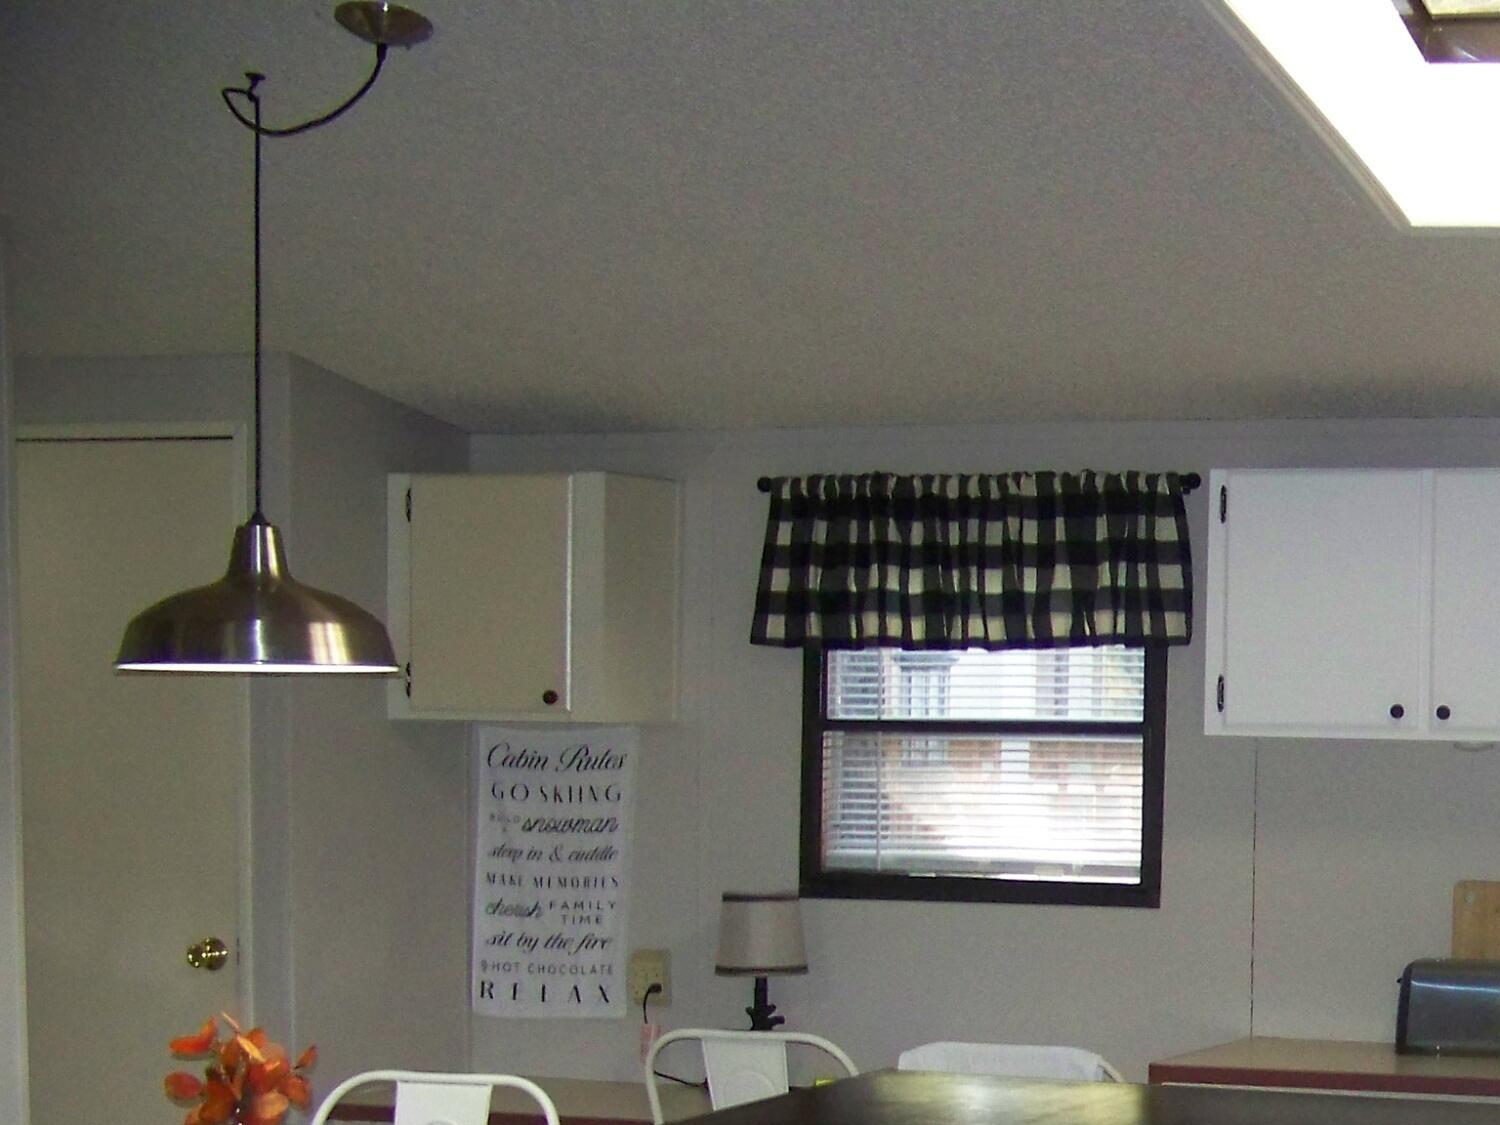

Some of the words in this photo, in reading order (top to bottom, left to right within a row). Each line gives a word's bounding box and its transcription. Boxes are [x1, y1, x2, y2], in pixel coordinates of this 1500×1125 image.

[488, 743, 549, 770] Cabin
[555, 744, 628, 771] Rules
[491, 783, 529, 801] GO
[539, 784, 621, 803] SKIING
[521, 817, 619, 834] snowman
[488, 843, 523, 864] sleep
[526, 844, 544, 861] in
[549, 844, 564, 862] &
[568, 845, 619, 862] cuddle
[486, 872, 522, 886] MAKE
[533, 875, 619, 889] MEMORIES
[549, 900, 616, 911] FAMILY
[561, 914, 603, 925] TIME
[486, 930, 514, 946] sit
[516, 931, 540, 955] by
[543, 932, 575, 949] the
[567, 932, 614, 956] fire
[491, 961, 520, 973] HOT
[527, 962, 614, 976] CHOCOLATE
[479, 980, 610, 1004] RELAX
